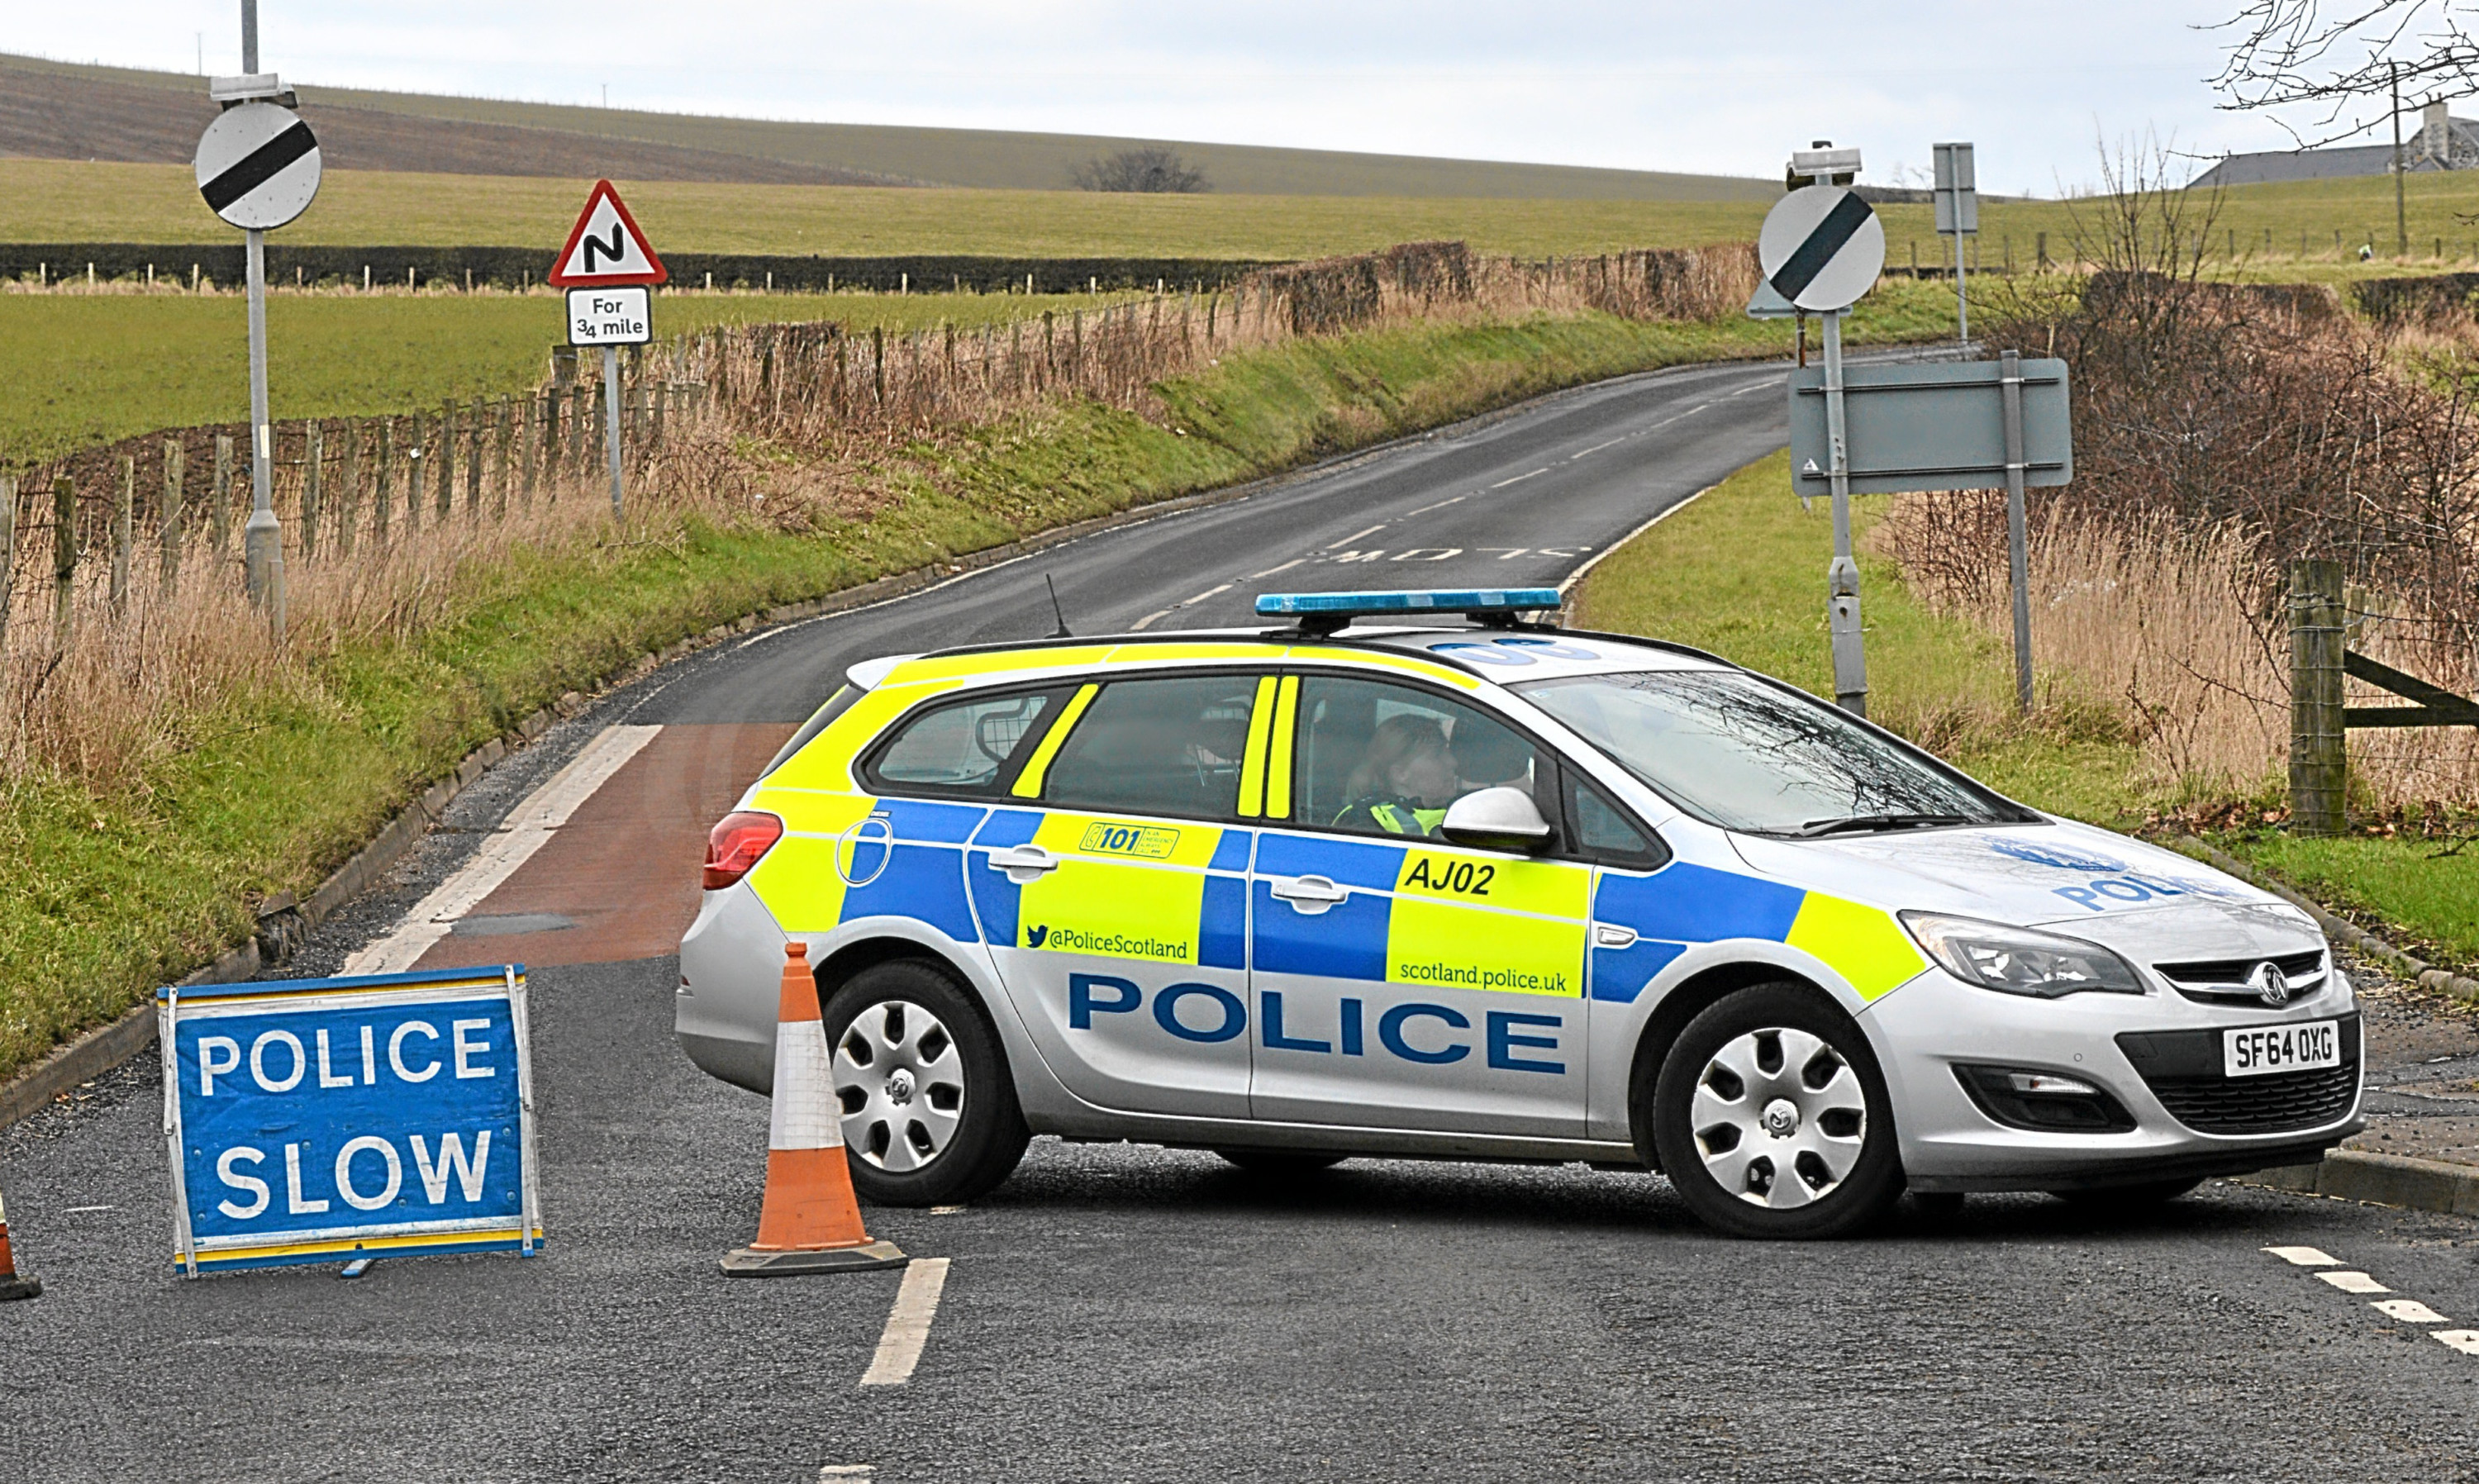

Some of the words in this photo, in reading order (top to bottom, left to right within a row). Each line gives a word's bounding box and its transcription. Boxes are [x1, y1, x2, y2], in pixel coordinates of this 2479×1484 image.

[592, 297, 623, 314] For
[603, 318, 643, 335] mile
[1099, 827, 1141, 851] 101
[1404, 858, 1496, 896] AJ02
[1049, 930, 1187, 960] @PoliceScotland
[1400, 962, 1567, 992] scotland.police.uk
[1068, 972, 1566, 1074] POLICE
[197, 1018, 496, 1096] POLICE
[2235, 1030, 2294, 1068] SF64
[2298, 1026, 2332, 1062] OXG
[216, 1130, 492, 1220] SLOW
